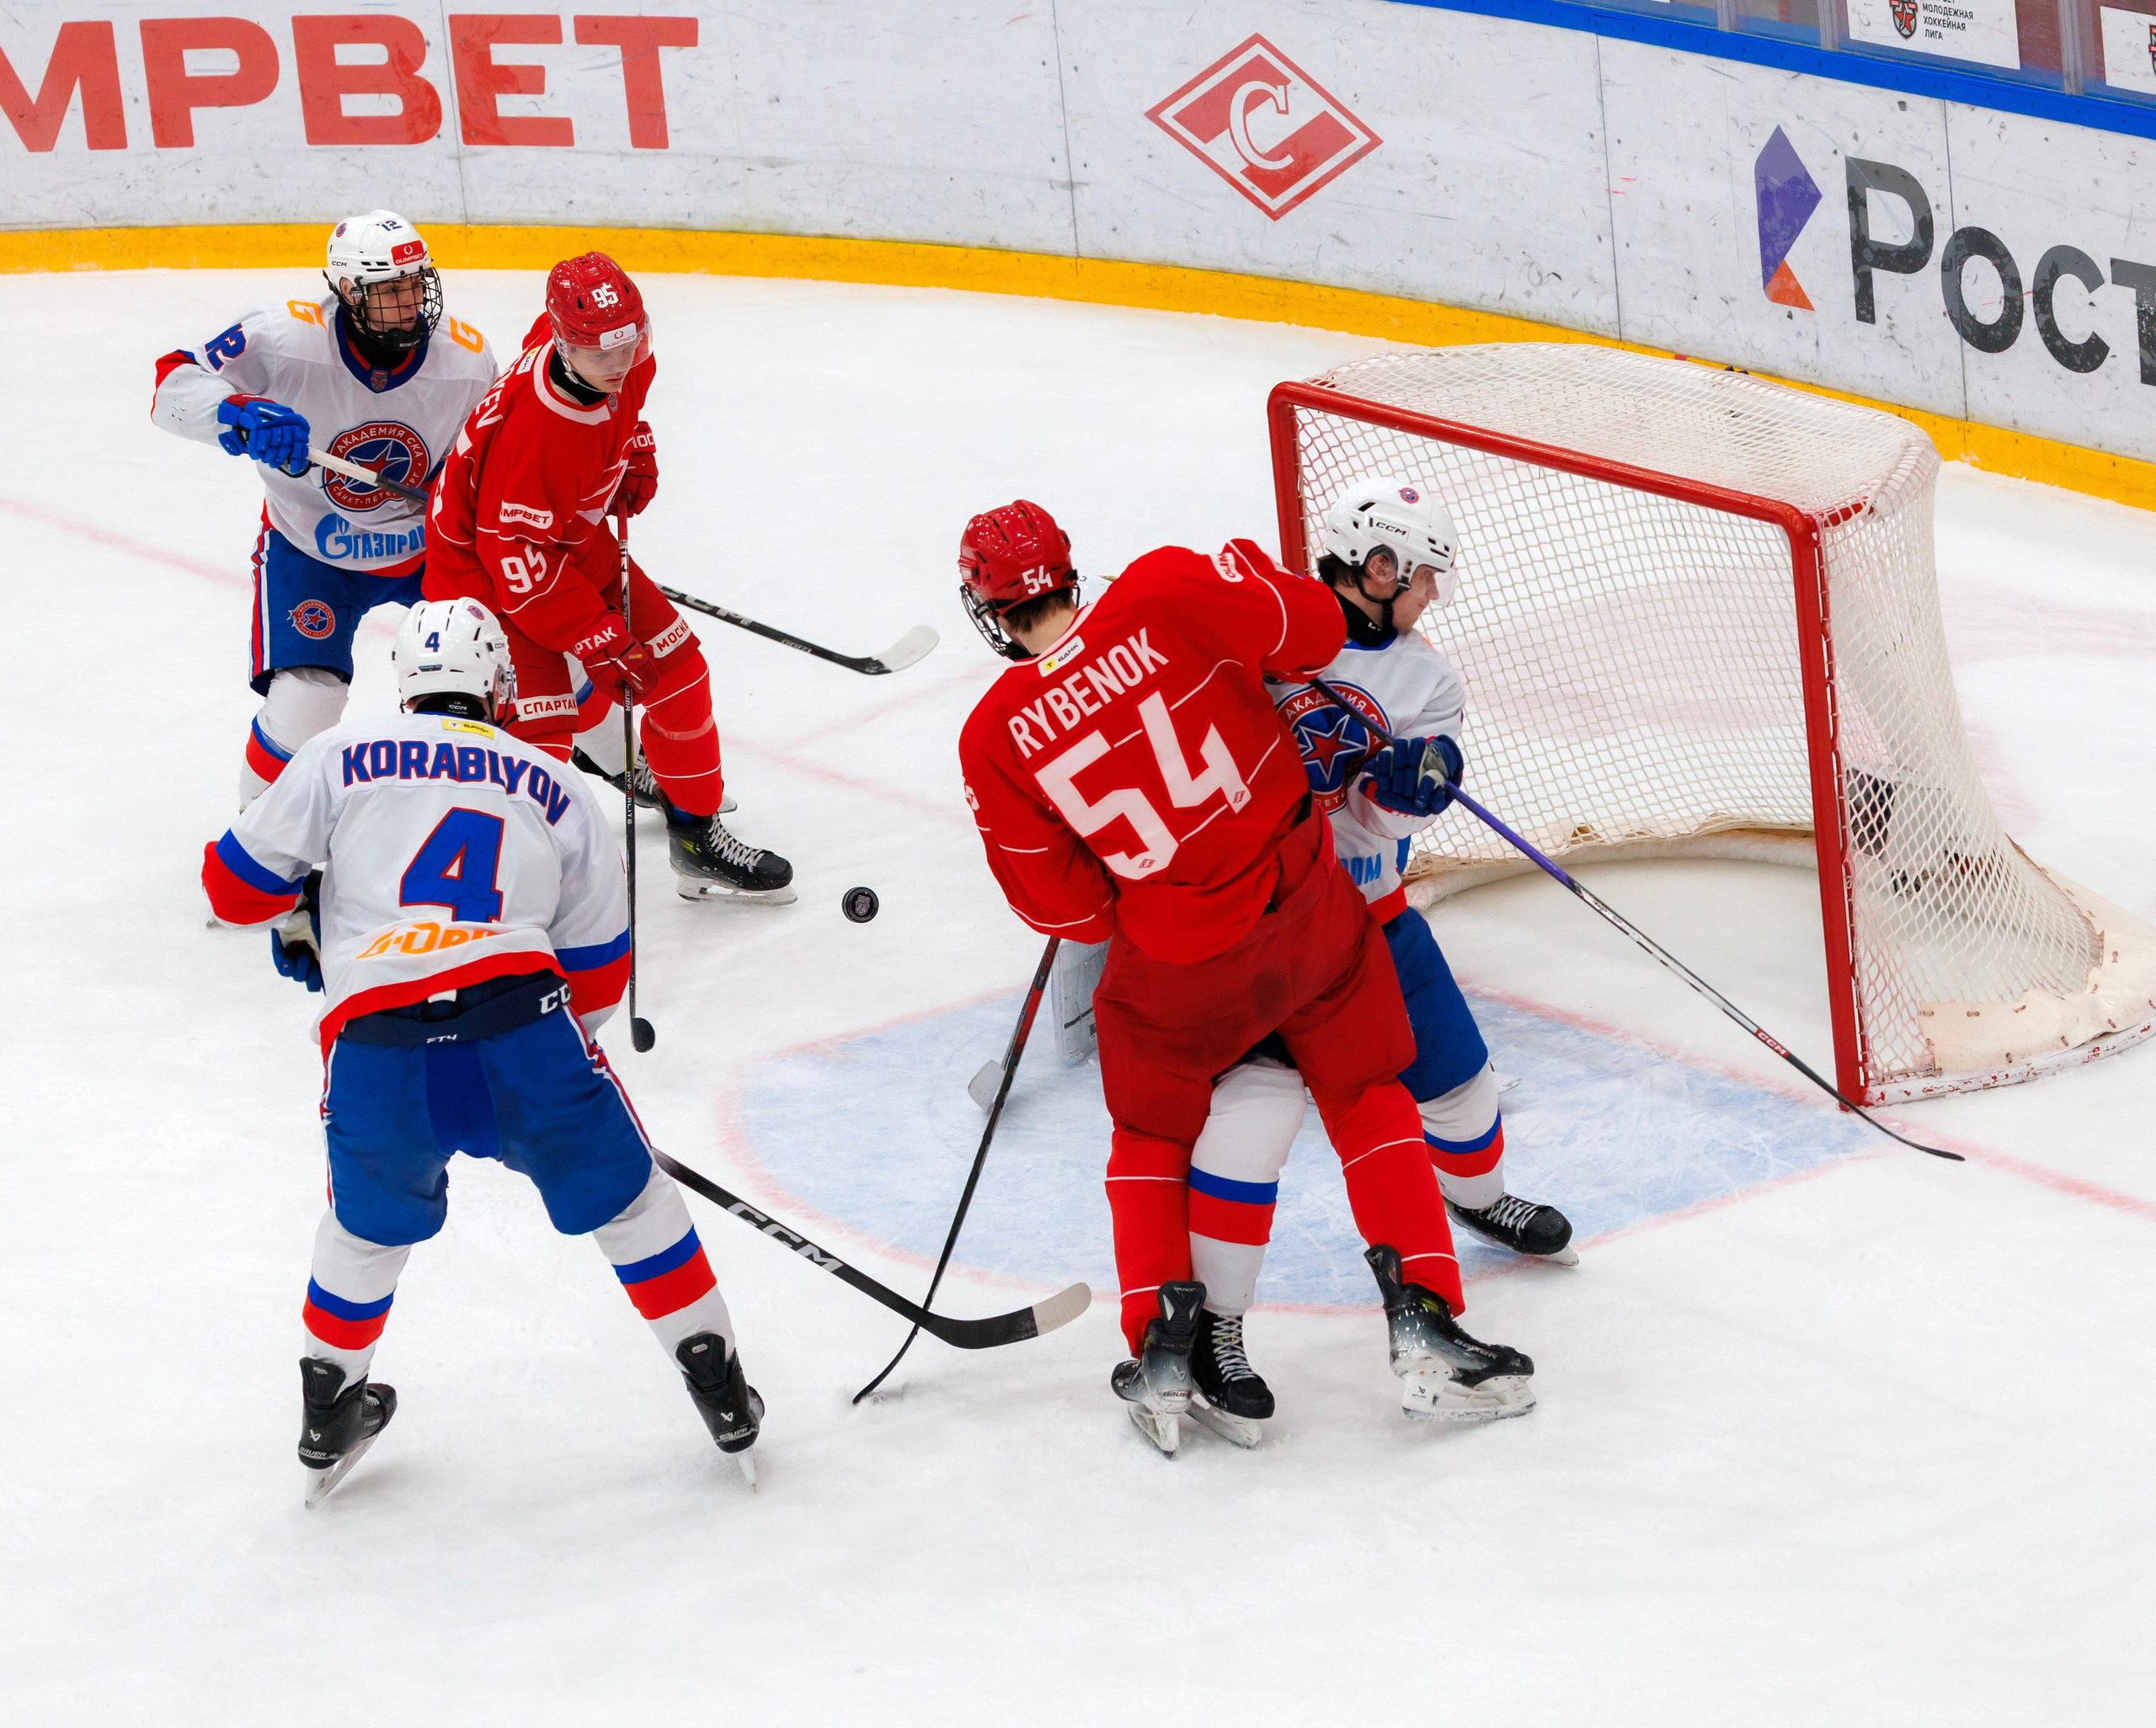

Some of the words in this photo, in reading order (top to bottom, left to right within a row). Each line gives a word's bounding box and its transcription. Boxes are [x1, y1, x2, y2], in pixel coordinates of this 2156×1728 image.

[1922, 3, 1974, 20] МОЛОДЕЖНАЯ
[1923, 15, 1967, 32] ХОККЕЙНАЯ
[1924, 29, 1944, 40] ЛИГА
[395, 253, 424, 264] OLIMPBET
[591, 281, 620, 309] 95
[337, 427, 406, 454] АКАДЕМИЯ
[407, 437, 424, 458] СКА
[333, 472, 420, 505] САНКТ-ПЕТЕРГ
[1375, 521, 1407, 536] CCM
[500, 542, 547, 594] 95
[1022, 564, 1054, 595] 54
[424, 632, 440, 653] 4
[1058, 643, 1080, 663] БАНК
[1007, 627, 1170, 760] RYBENOK
[342, 739, 572, 827] KORABLYOV
[1033, 690, 1252, 881] 54
[399, 806, 504, 924] 4
[1758, 1032, 1787, 1055] CCM
[727, 1202, 844, 1272] CCM
